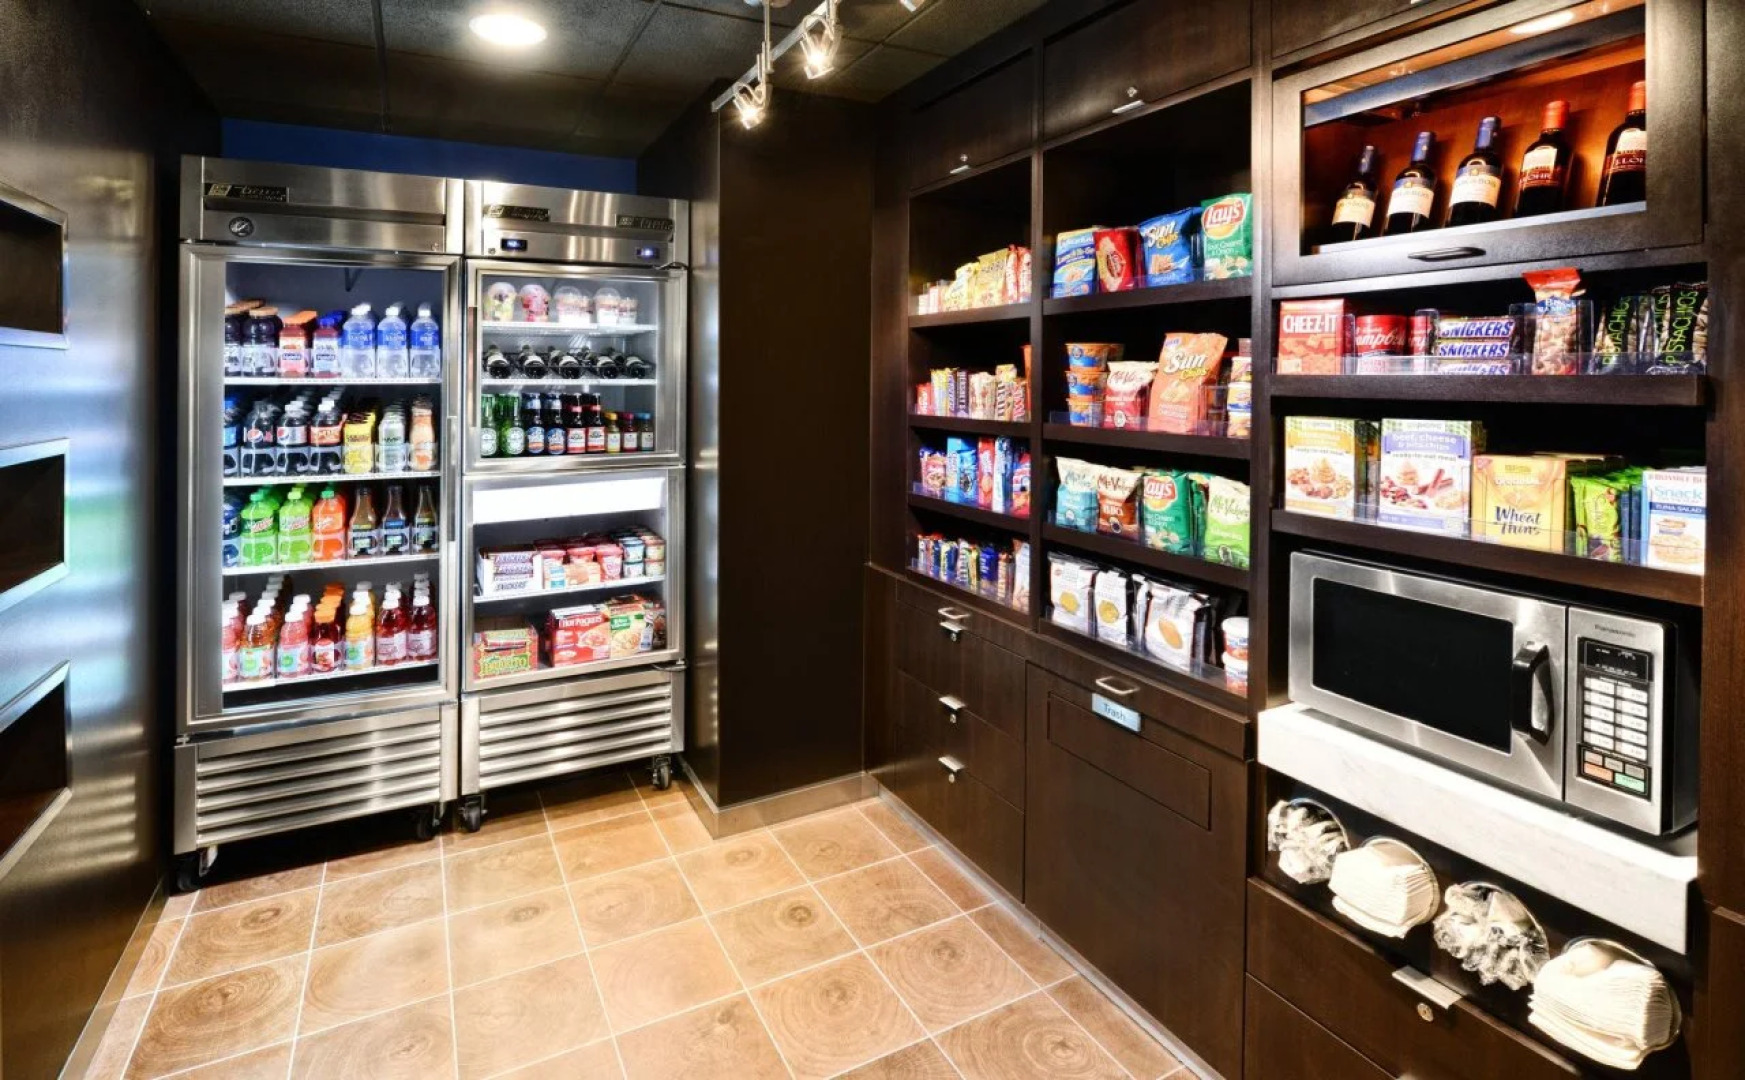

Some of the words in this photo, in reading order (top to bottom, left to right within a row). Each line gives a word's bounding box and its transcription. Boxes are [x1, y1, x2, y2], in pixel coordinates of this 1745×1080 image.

[1205, 201, 1241, 228] Lay's
[1146, 221, 1176, 247] Sun
[1283, 314, 1337, 333] CHEEZ-IT
[1442, 321, 1514, 337] SNICKERS
[1440, 343, 1508, 358] SNICKERS
[1163, 351, 1208, 374] Sun
[1654, 485, 1703, 500] Snack
[1494, 505, 1542, 525] Wheat
[1103, 702, 1126, 721] Trash
